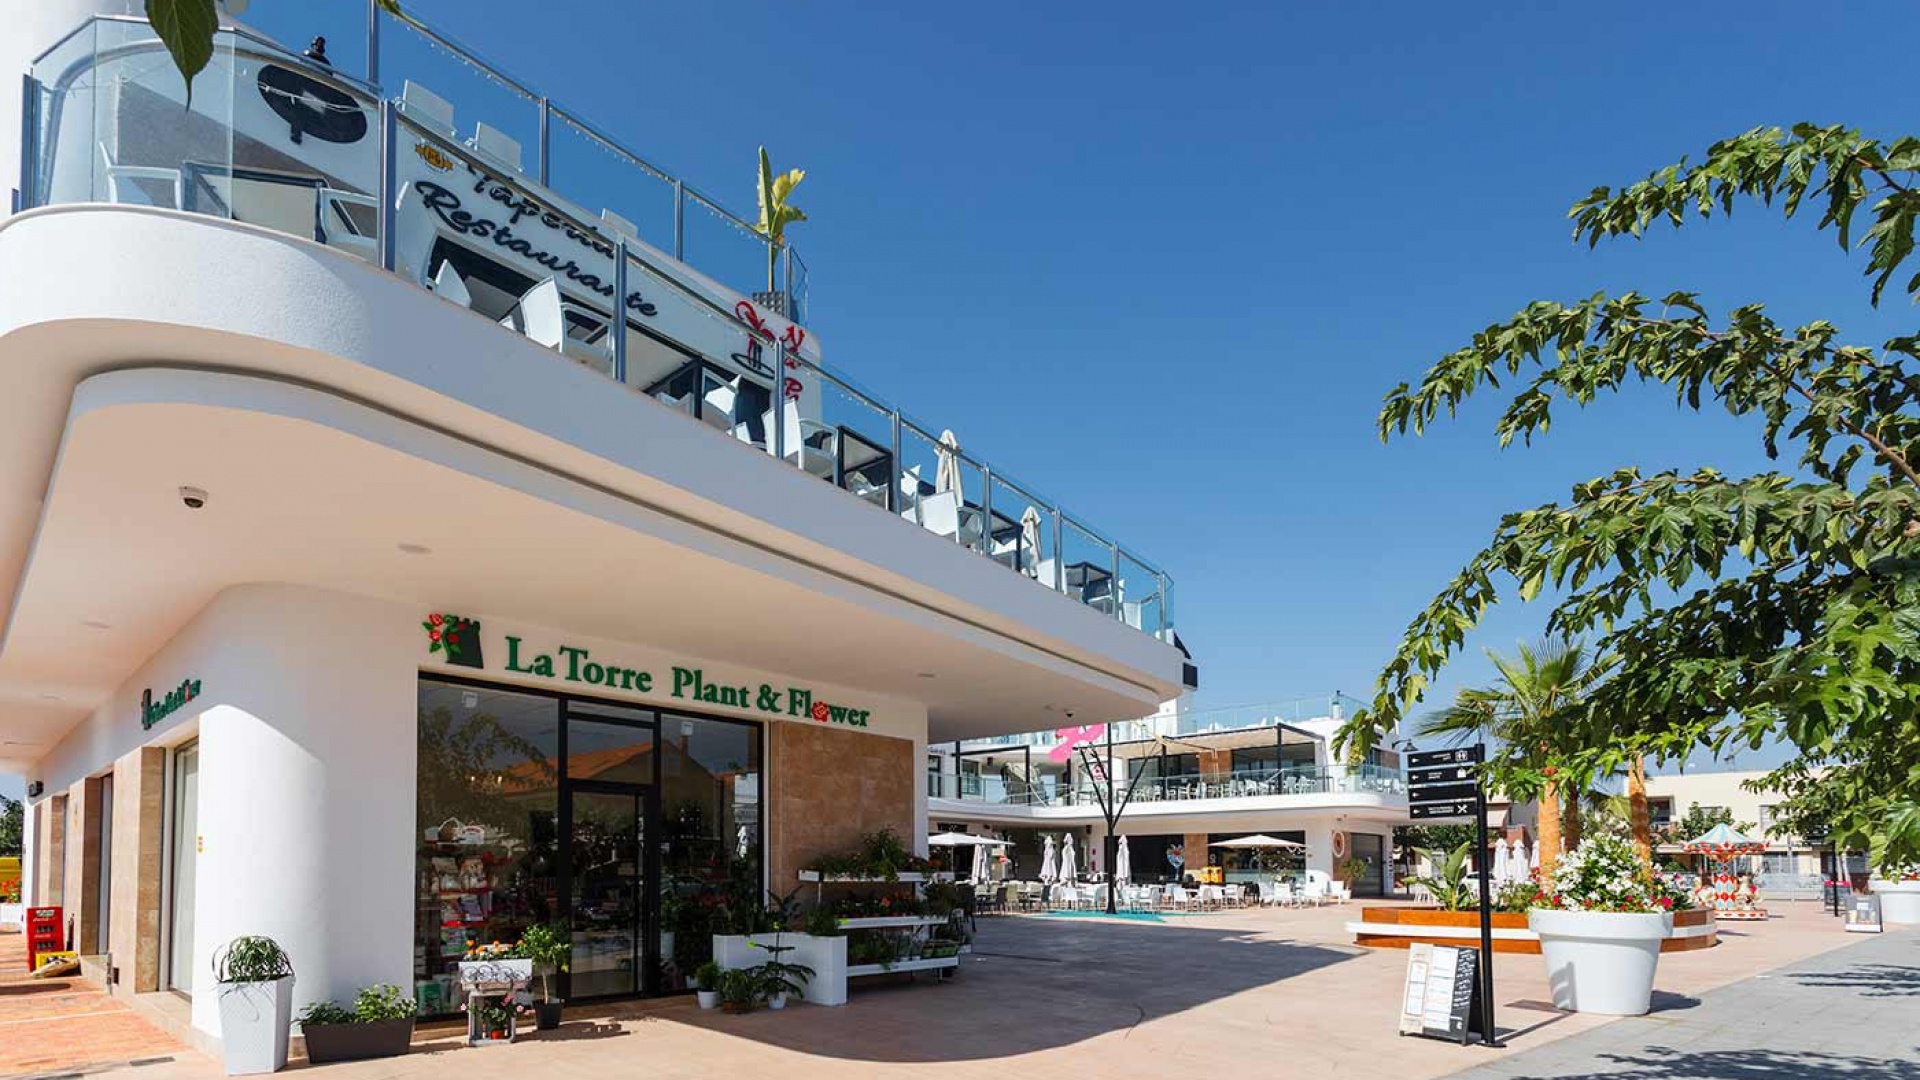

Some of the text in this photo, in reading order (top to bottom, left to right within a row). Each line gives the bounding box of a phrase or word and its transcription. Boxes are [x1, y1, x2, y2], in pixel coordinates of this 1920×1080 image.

[505, 636, 870, 727] La Torre Plant & Flower
